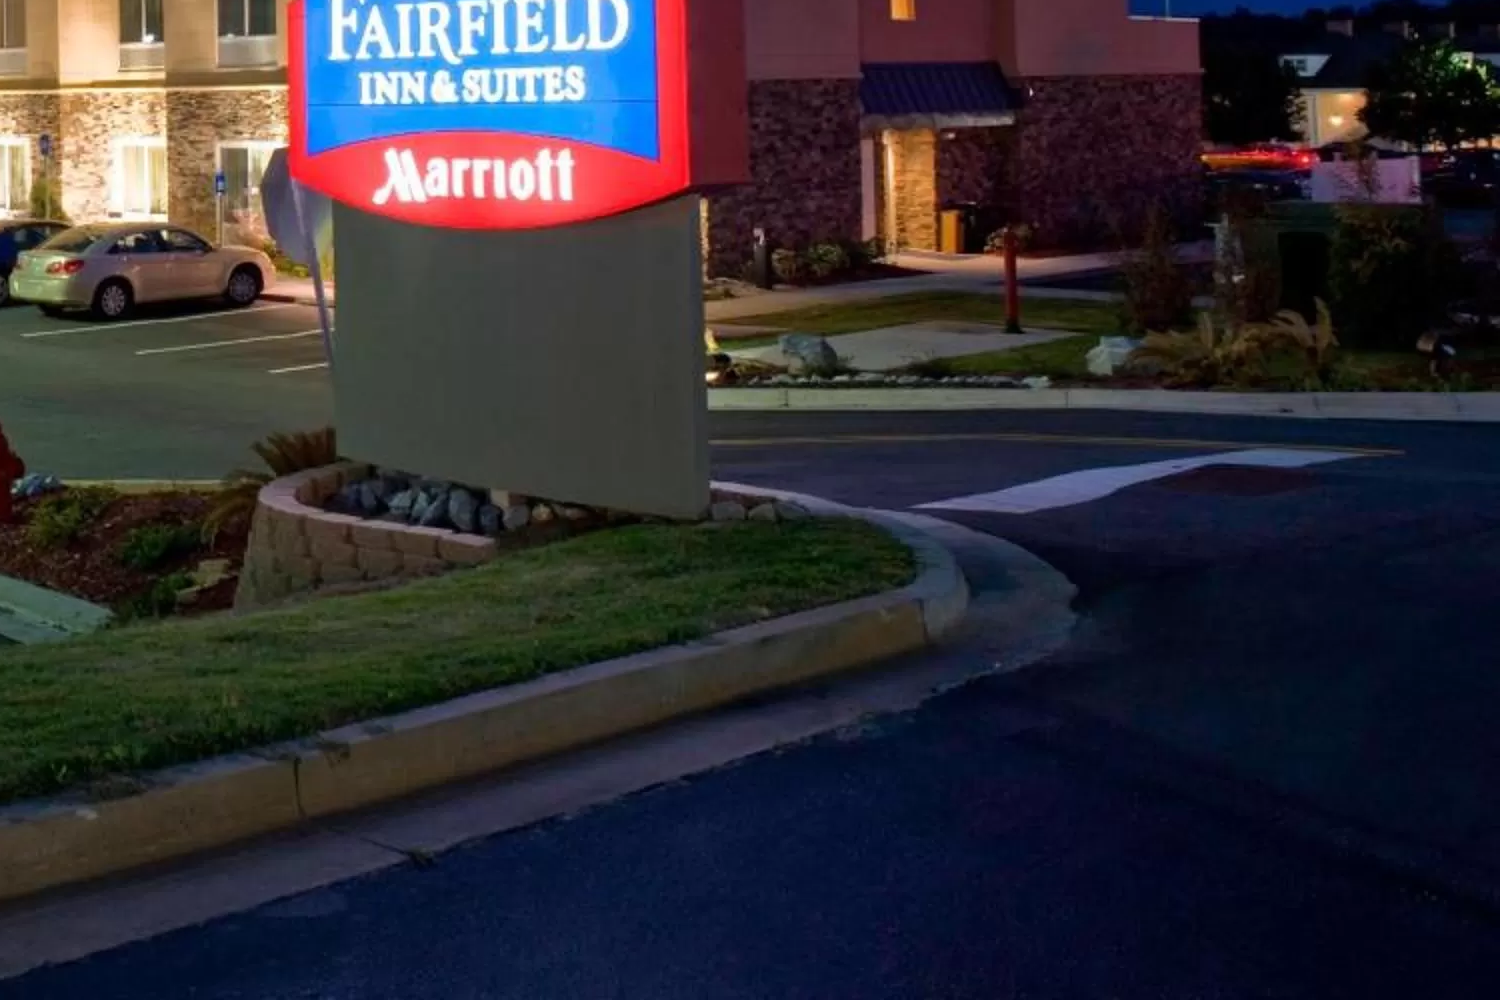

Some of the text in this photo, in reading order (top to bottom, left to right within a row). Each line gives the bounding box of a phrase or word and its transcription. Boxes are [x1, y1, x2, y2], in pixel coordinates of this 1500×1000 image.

[358, 65, 586, 105] INN & SUITES
[372, 147, 575, 205] Marriott
